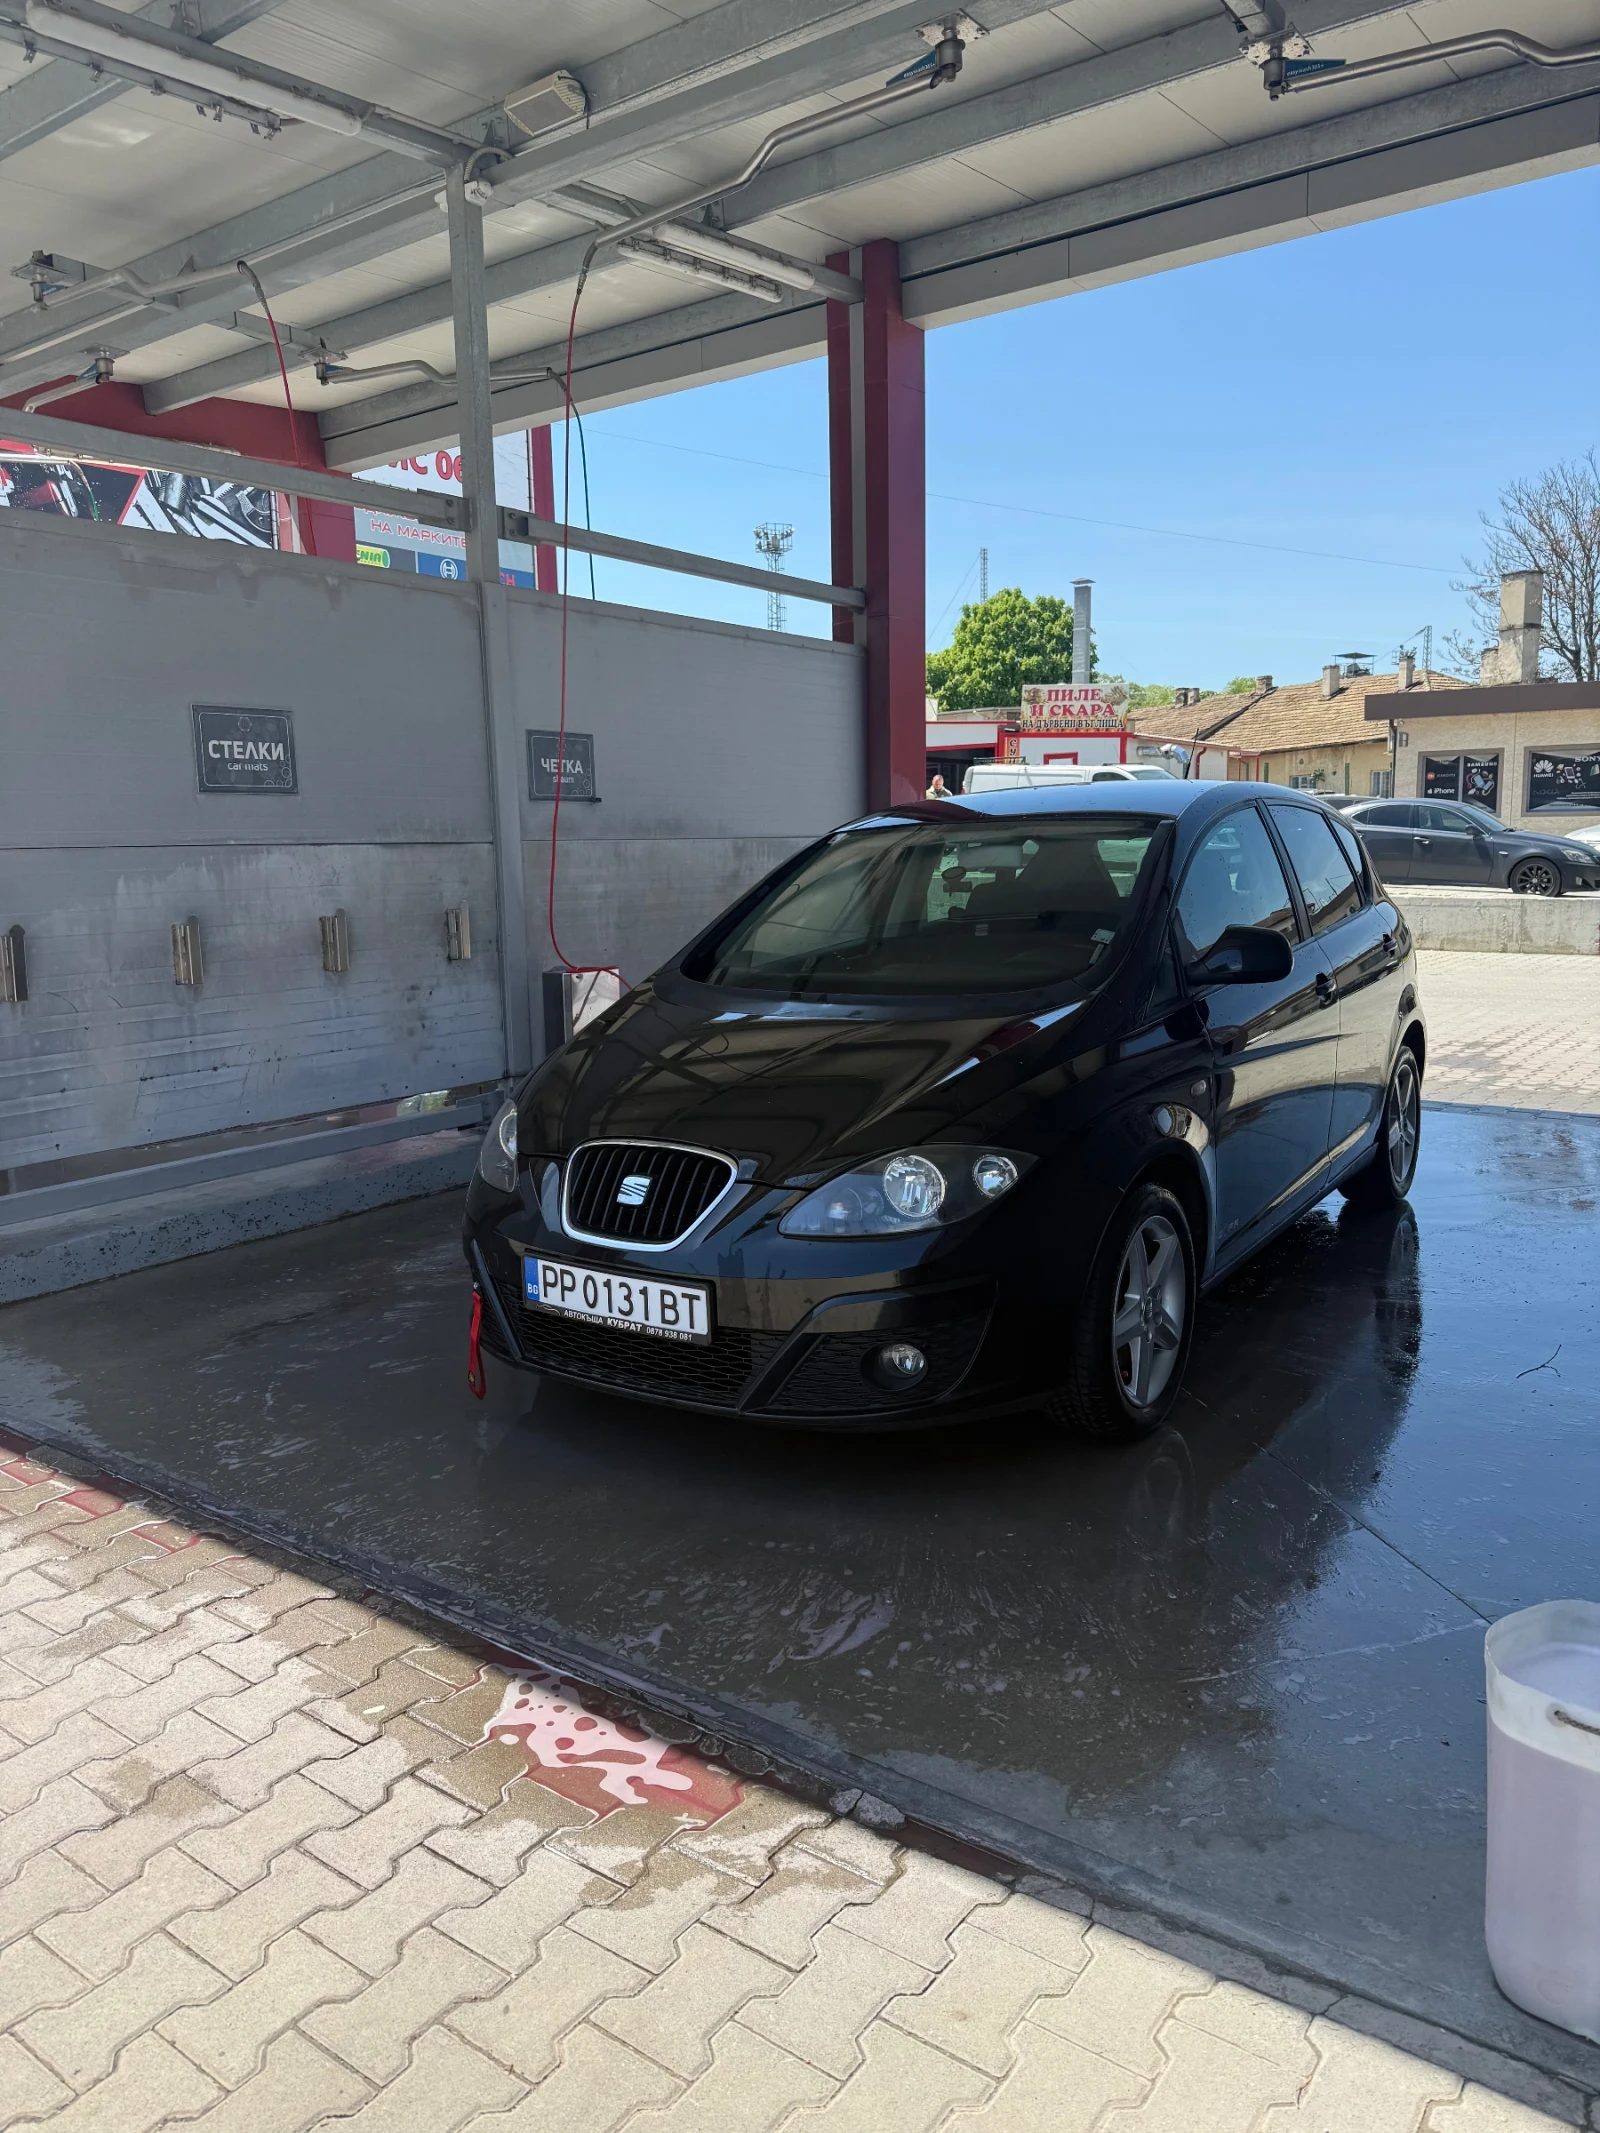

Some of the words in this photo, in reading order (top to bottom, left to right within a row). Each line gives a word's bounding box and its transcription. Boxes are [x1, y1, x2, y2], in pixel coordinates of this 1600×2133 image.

[371, 520, 392, 534] НА
[397, 524, 467, 549] МАРКИТЕ
[1047, 688, 1103, 702] ПИЛЕ
[1031, 704, 1044, 717] И
[1049, 703, 1116, 717] СКАРА
[1022, 719, 1034, 728] НА
[1036, 719, 1076, 729] ДЪРВЕНИ
[1078, 718, 1124, 728] ВЪГЛИЩА
[208, 739, 284, 761] СТЕЛКИ
[541, 757, 584, 774] ЧЕТКА
[1574, 755, 1600, 763] SONY
[227, 762, 242, 771] car
[245, 762, 269, 771] mats
[1433, 787, 1456, 795] iPhone
[527, 1282, 539, 1295] BG
[541, 1264, 577, 1303] PP
[582, 1273, 651, 1322] 0131
[659, 1288, 701, 1330] BT
[563, 1309, 604, 1324] АВТОКЪЩА
[607, 1317, 643, 1332] КУБРАТ
[646, 1326, 663, 1337] 0878
